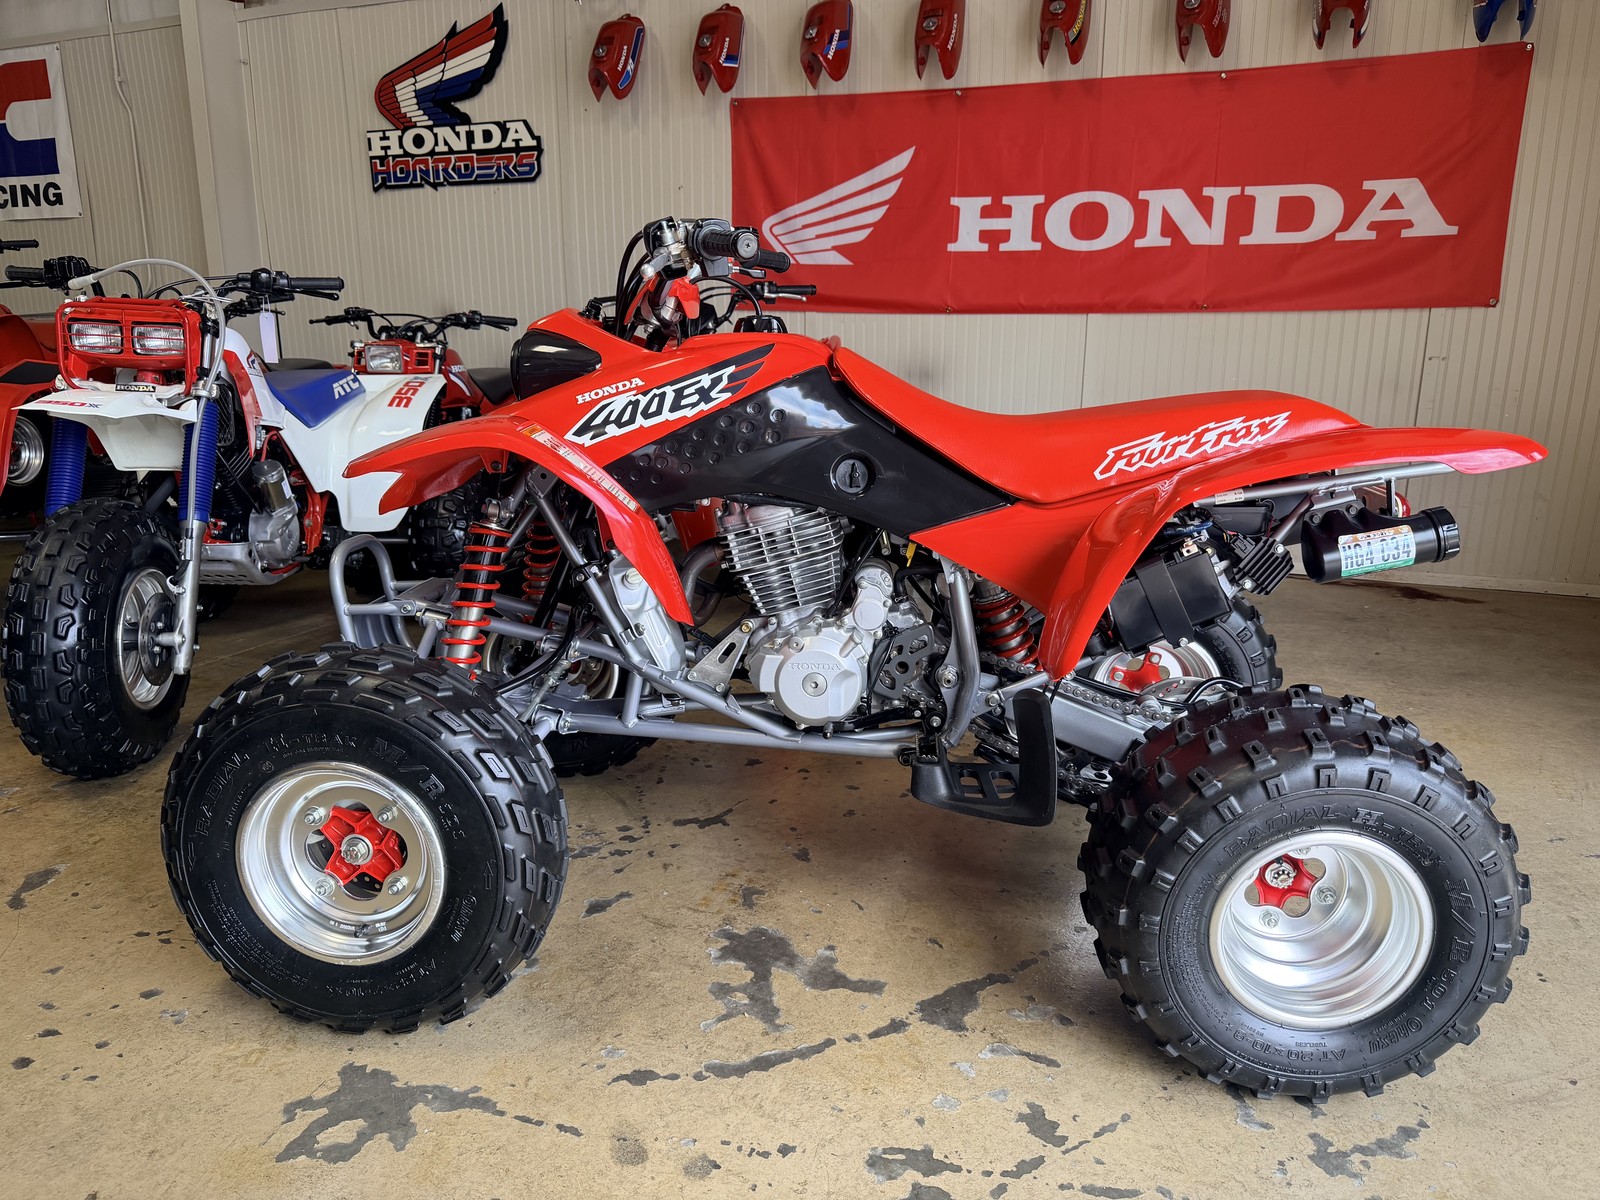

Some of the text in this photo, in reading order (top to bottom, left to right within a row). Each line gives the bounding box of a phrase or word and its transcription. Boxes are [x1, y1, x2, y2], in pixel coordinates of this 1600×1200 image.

[827, 28, 841, 60] HONDA
[946, 13, 959, 51] HONDA
[617, 45, 628, 72] HONDA
[719, 37, 730, 65] HONDA
[366, 120, 538, 157] HONDA
[371, 151, 539, 188] HOARDERS
[946, 177, 1459, 252] HONDA
[116, 384, 155, 392] HONDA
[332, 374, 361, 400] ATC
[575, 377, 646, 405] HONDA
[563, 364, 736, 448] 400EX
[788, 662, 841, 671] HONDA
[195, 752, 250, 836] RADIAL
[1223, 804, 1339, 858] RADIAL
[1423, 968, 1459, 1011] 501
[1369, 1016, 1424, 1054] Ohtsu
[1319, 1047, 1346, 1062] AT
